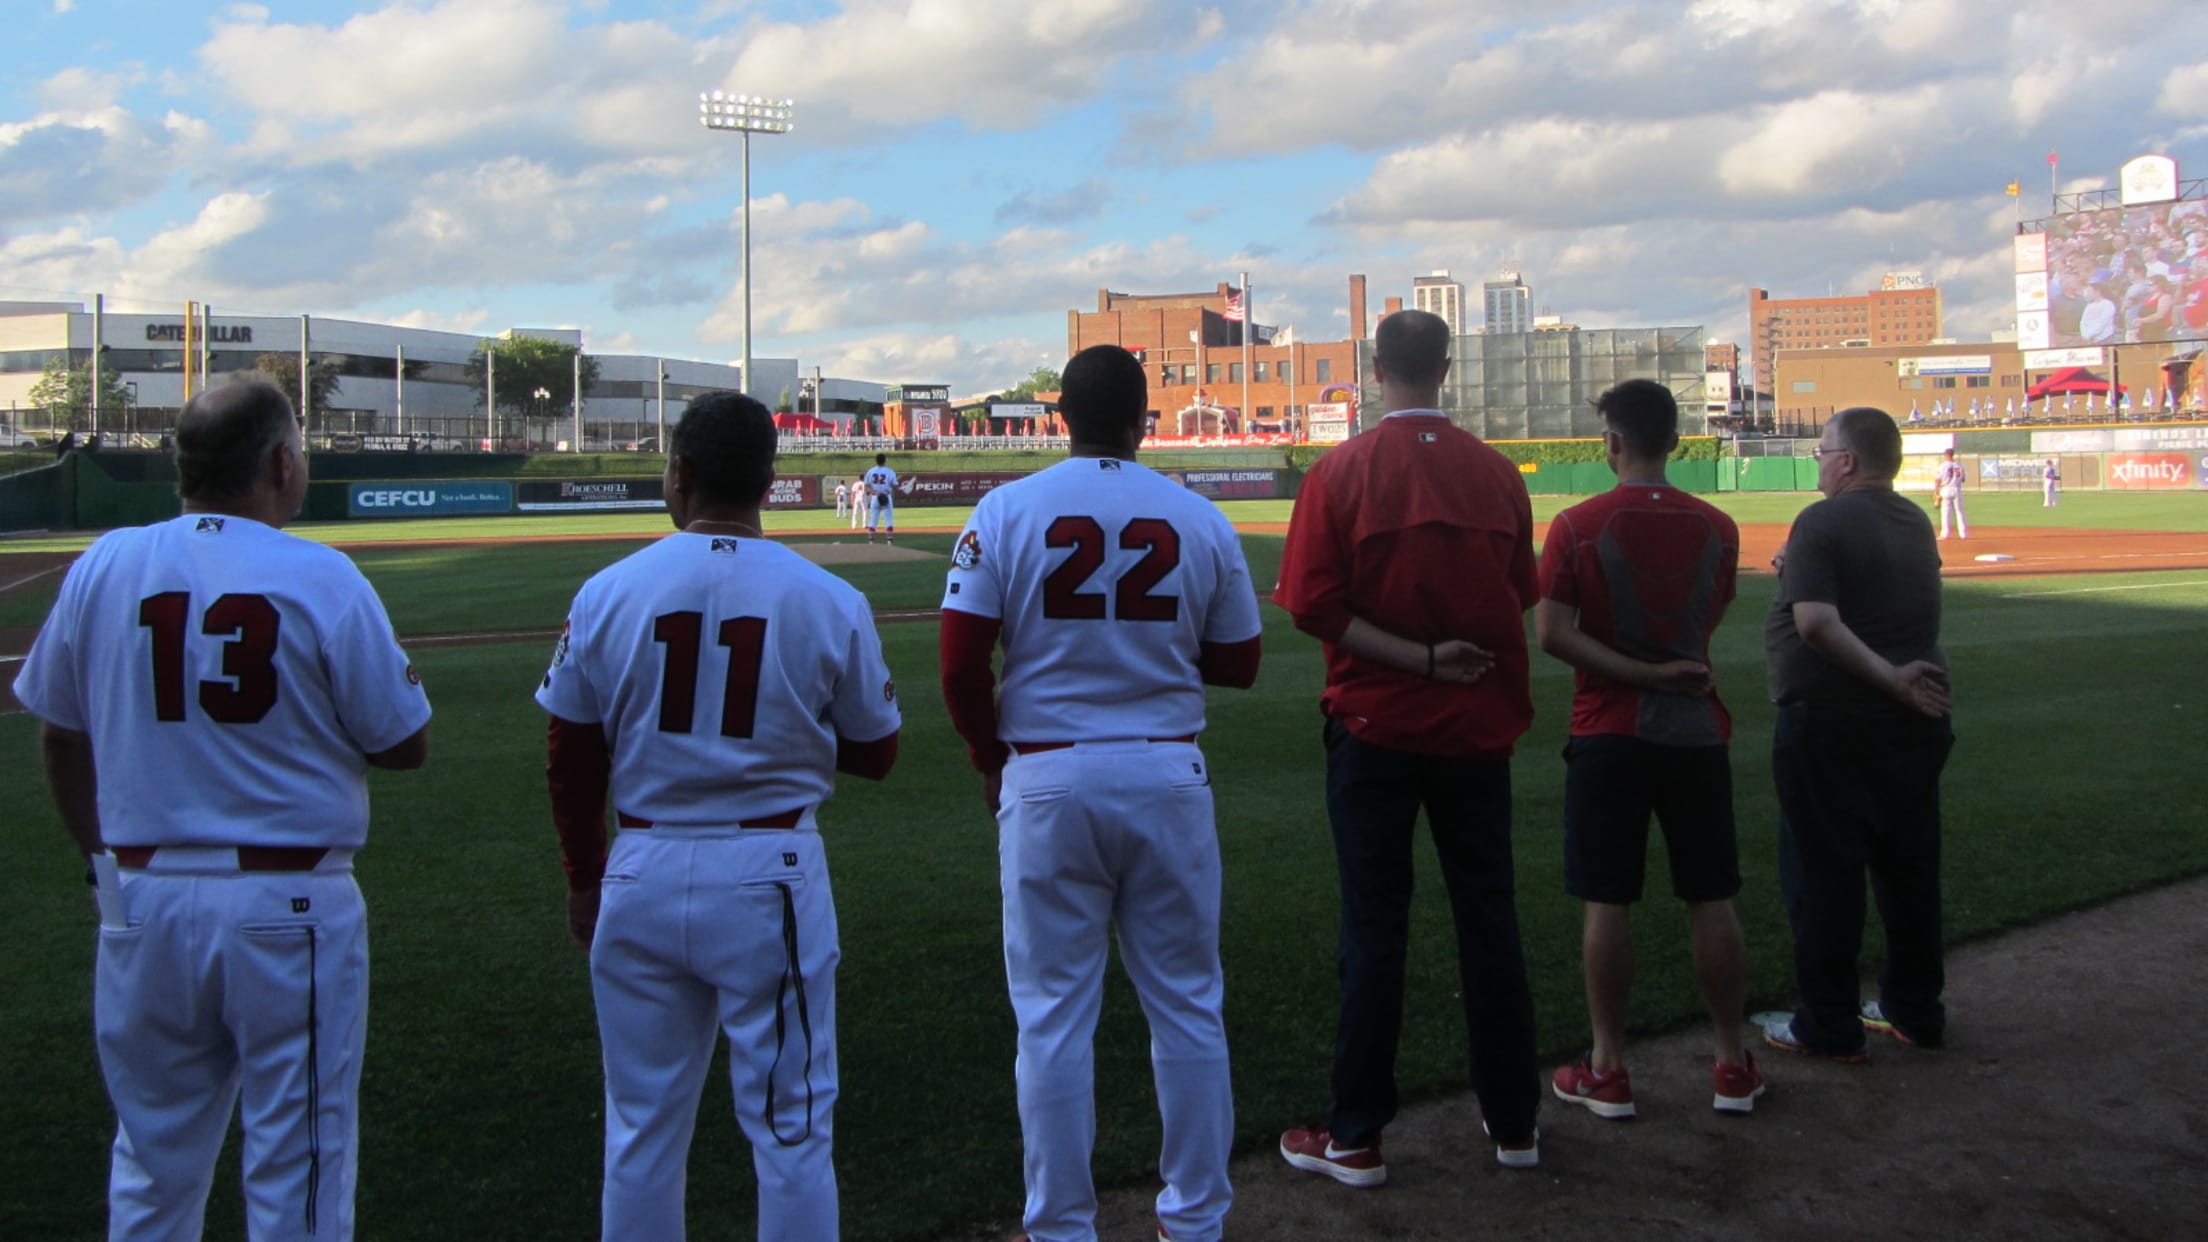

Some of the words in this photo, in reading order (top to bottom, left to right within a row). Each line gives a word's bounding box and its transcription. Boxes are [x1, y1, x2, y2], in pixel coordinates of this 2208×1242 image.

[1897, 275, 1922, 286] PNC
[871, 472, 887, 485] 32
[1186, 472, 1231, 482] PROFESSIONAL
[1231, 471, 1274, 481] ELECTRICIANS
[2112, 460, 2184, 482] xfinity
[560, 482, 629, 497] KROESCHELL
[915, 482, 954, 491] PEKIN
[358, 490, 436, 508] CEFCU
[768, 494, 803, 504] BUDS
[1043, 515, 1181, 622] 22
[139, 591, 281, 725] 13
[653, 611, 768, 740] 11
